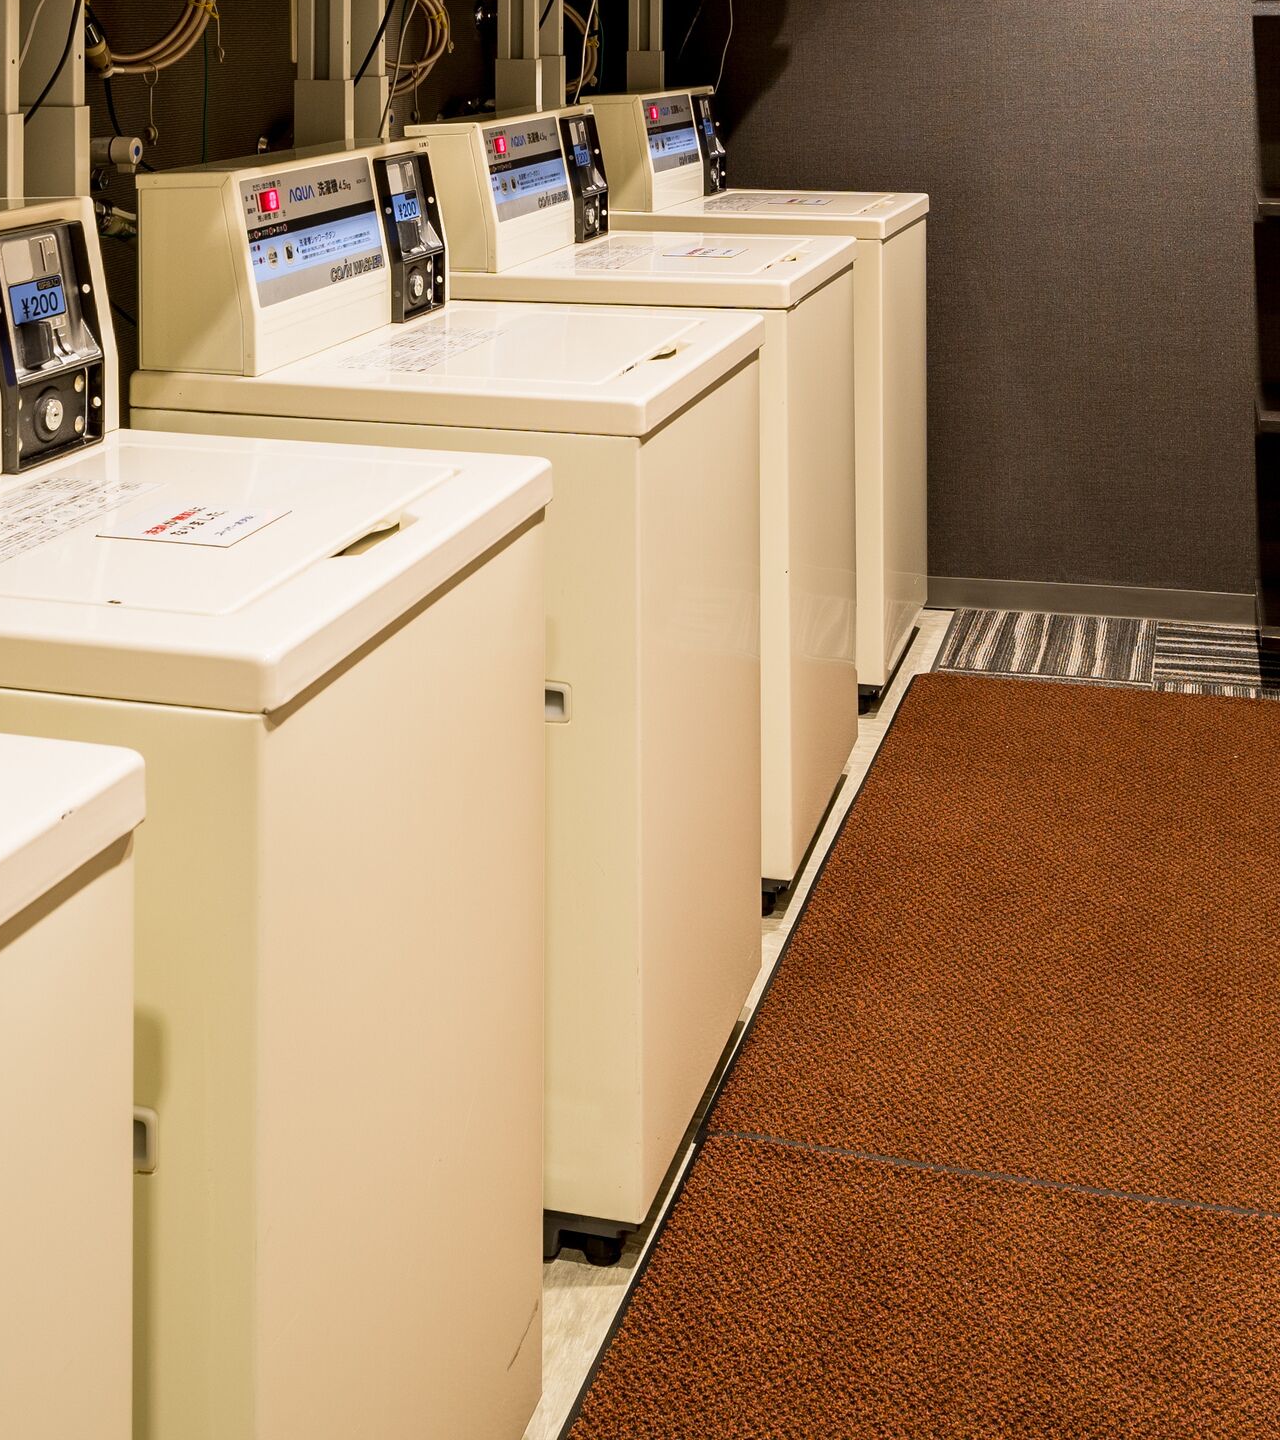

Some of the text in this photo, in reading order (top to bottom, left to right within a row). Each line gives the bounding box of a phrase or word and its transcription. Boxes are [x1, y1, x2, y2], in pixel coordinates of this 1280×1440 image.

[288, 184, 316, 204] AQUA
[397, 201, 418, 220] ¥200
[21, 291, 58, 319] ¥200
